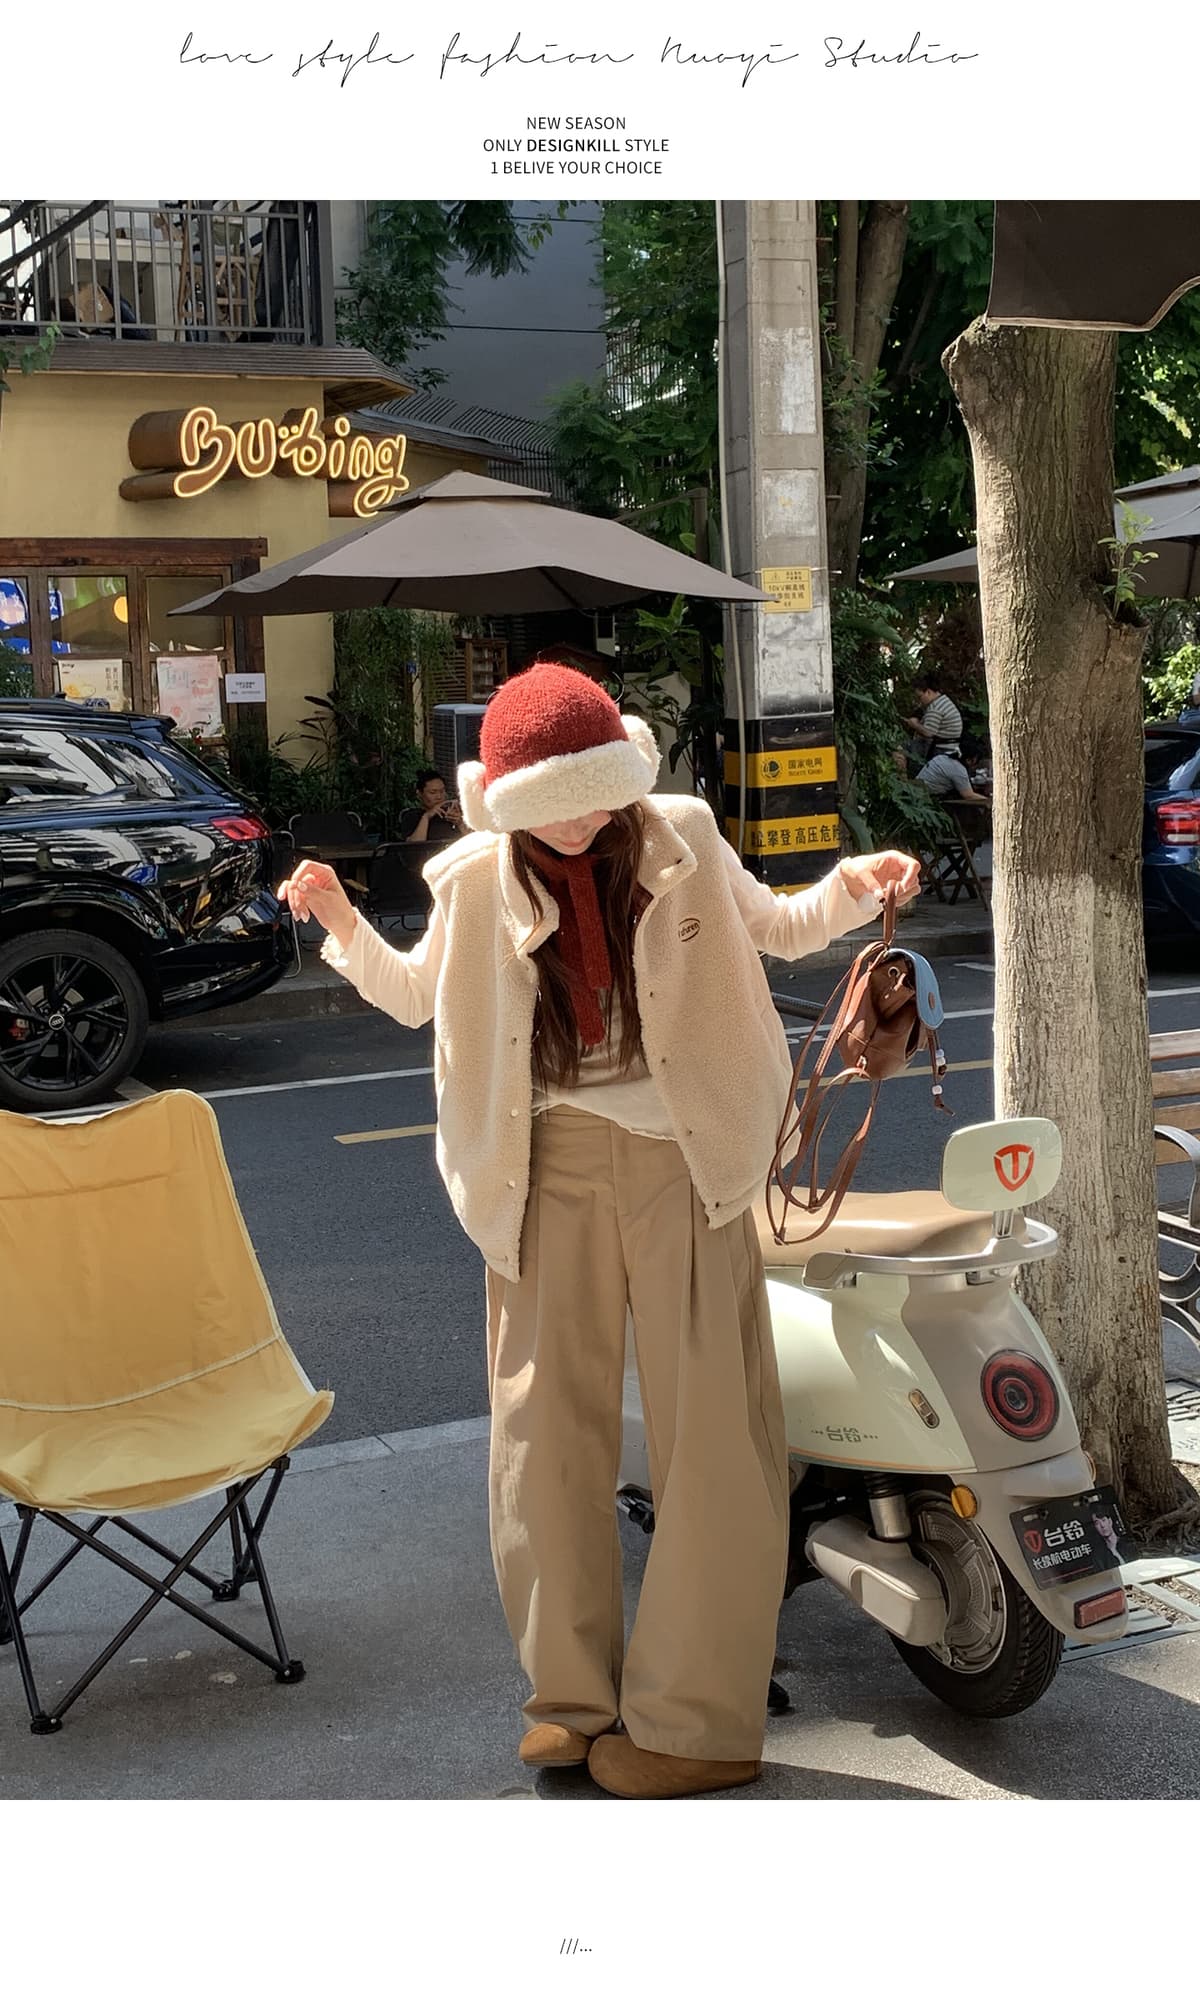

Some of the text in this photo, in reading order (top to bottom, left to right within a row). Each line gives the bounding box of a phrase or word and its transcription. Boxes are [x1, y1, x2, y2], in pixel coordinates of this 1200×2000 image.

[788, 757, 823, 769] 国家电网
[1044, 1520, 1085, 1547] 台铃
